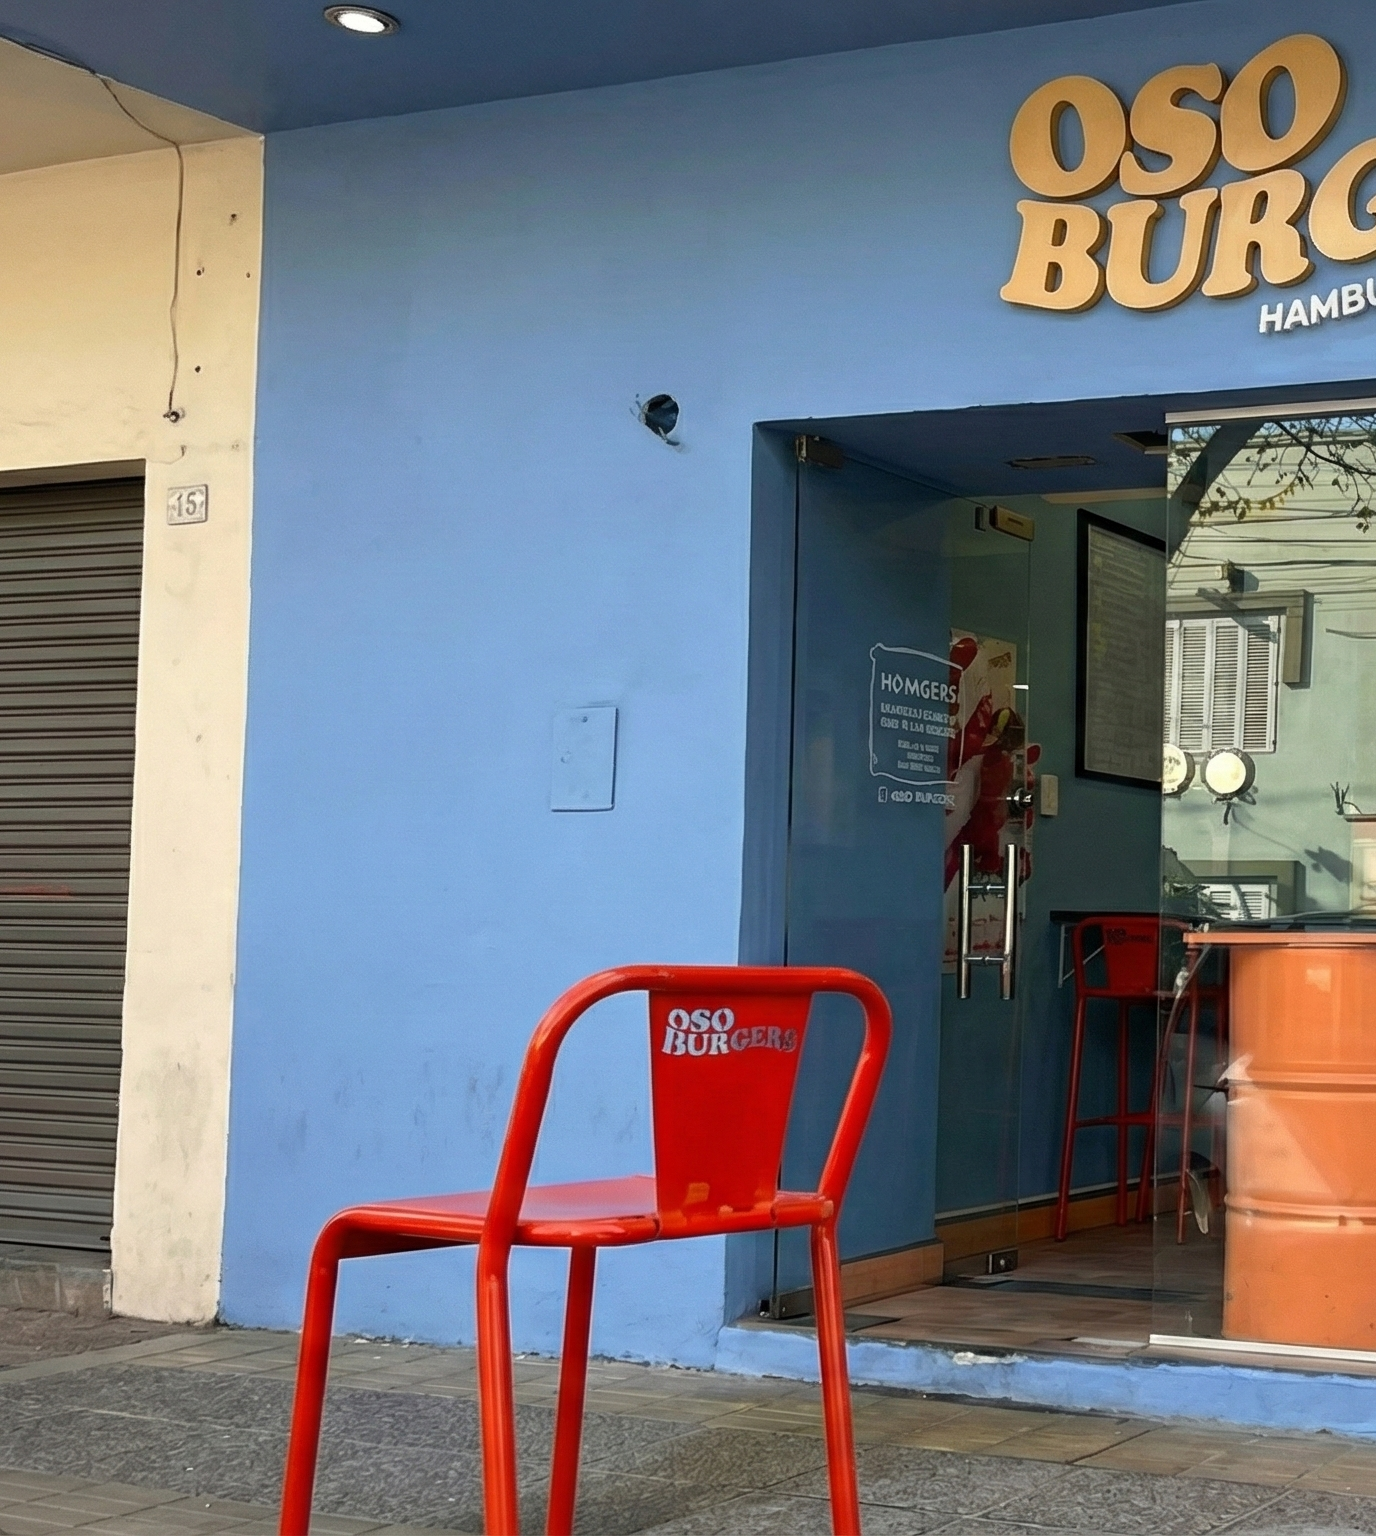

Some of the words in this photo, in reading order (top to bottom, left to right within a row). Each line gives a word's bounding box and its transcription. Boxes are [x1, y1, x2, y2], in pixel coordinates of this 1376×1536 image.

[1009, 33, 1346, 198] OSO
[176, 491, 197, 517] 15
[667, 1007, 735, 1032] OSO
